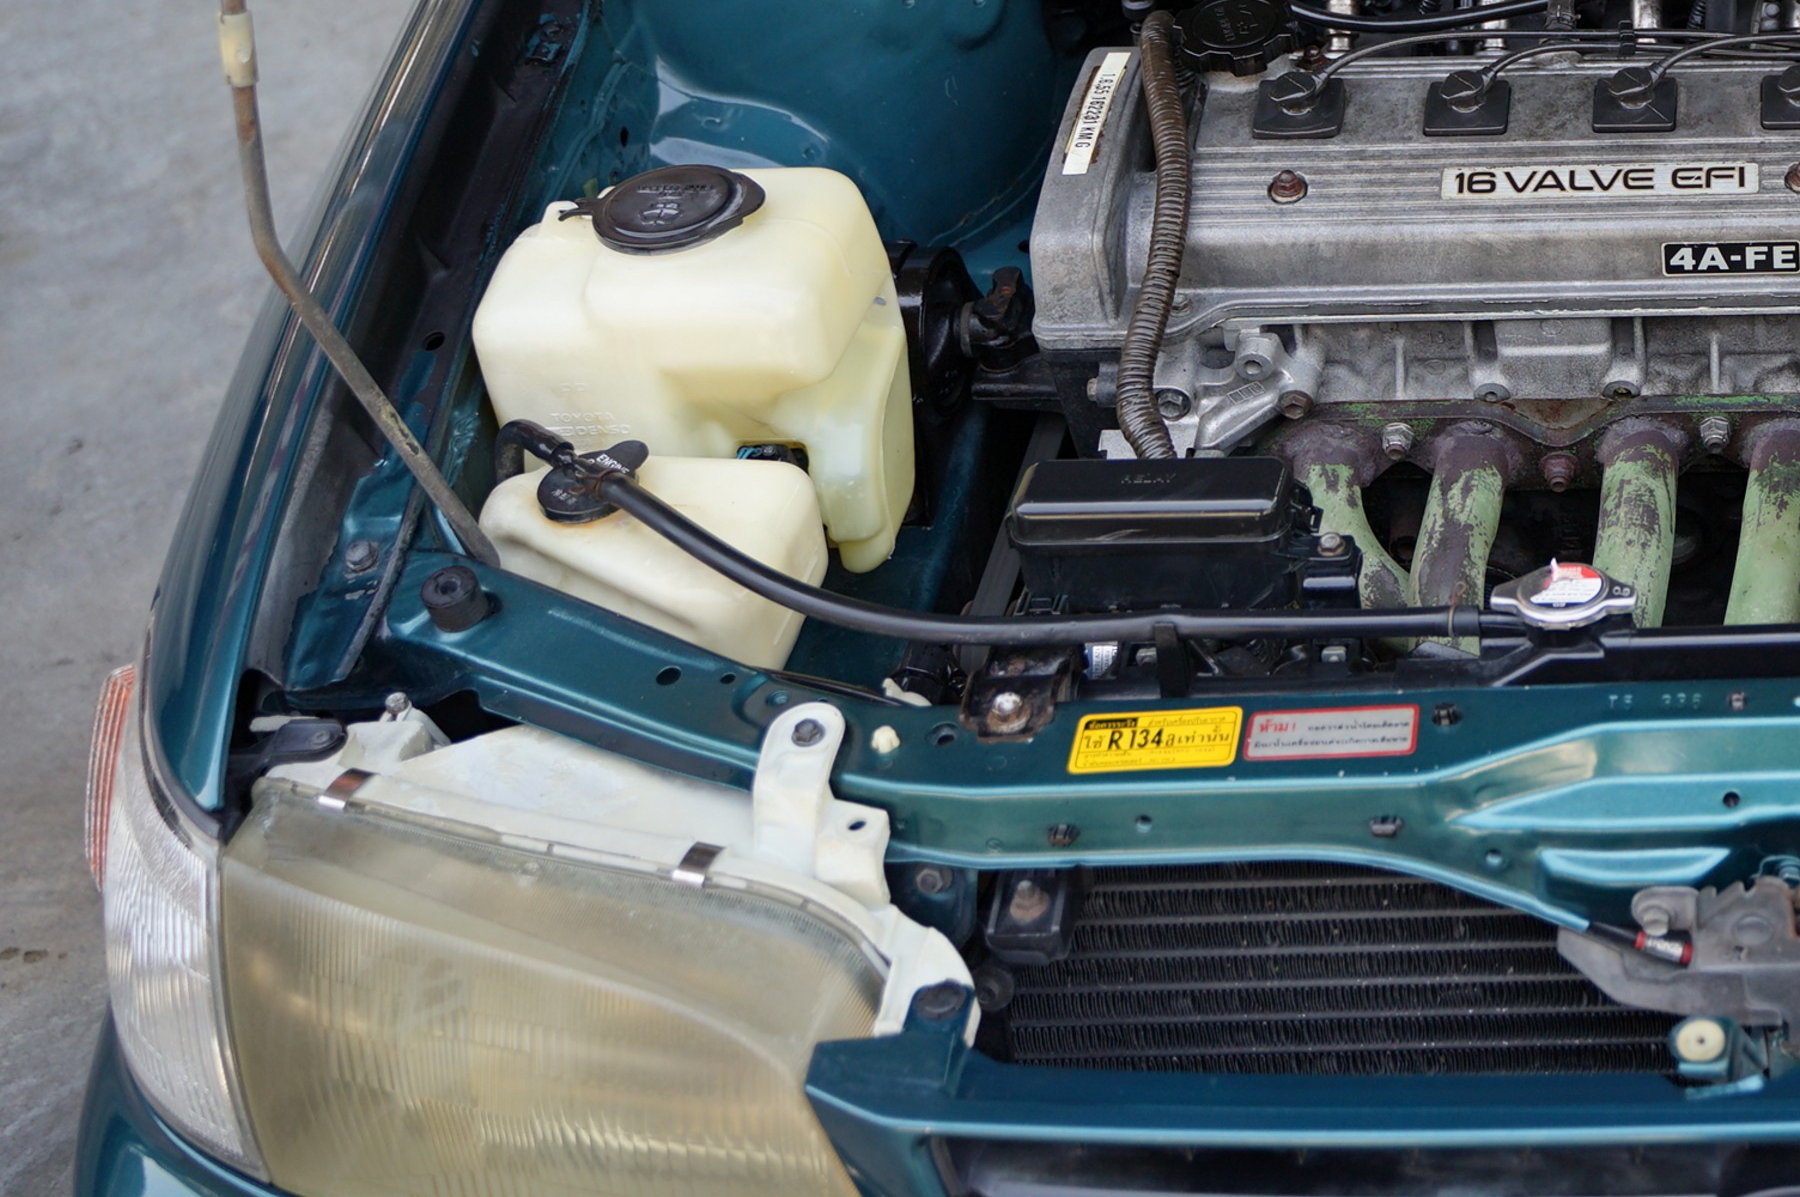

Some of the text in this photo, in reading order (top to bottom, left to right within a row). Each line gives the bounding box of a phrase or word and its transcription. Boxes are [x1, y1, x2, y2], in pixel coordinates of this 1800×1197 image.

[1454, 166, 1746, 194] 16 VALVE EFI
[1669, 245, 1797, 271] 4A-FE
[549, 411, 616, 423] TOYOTA
